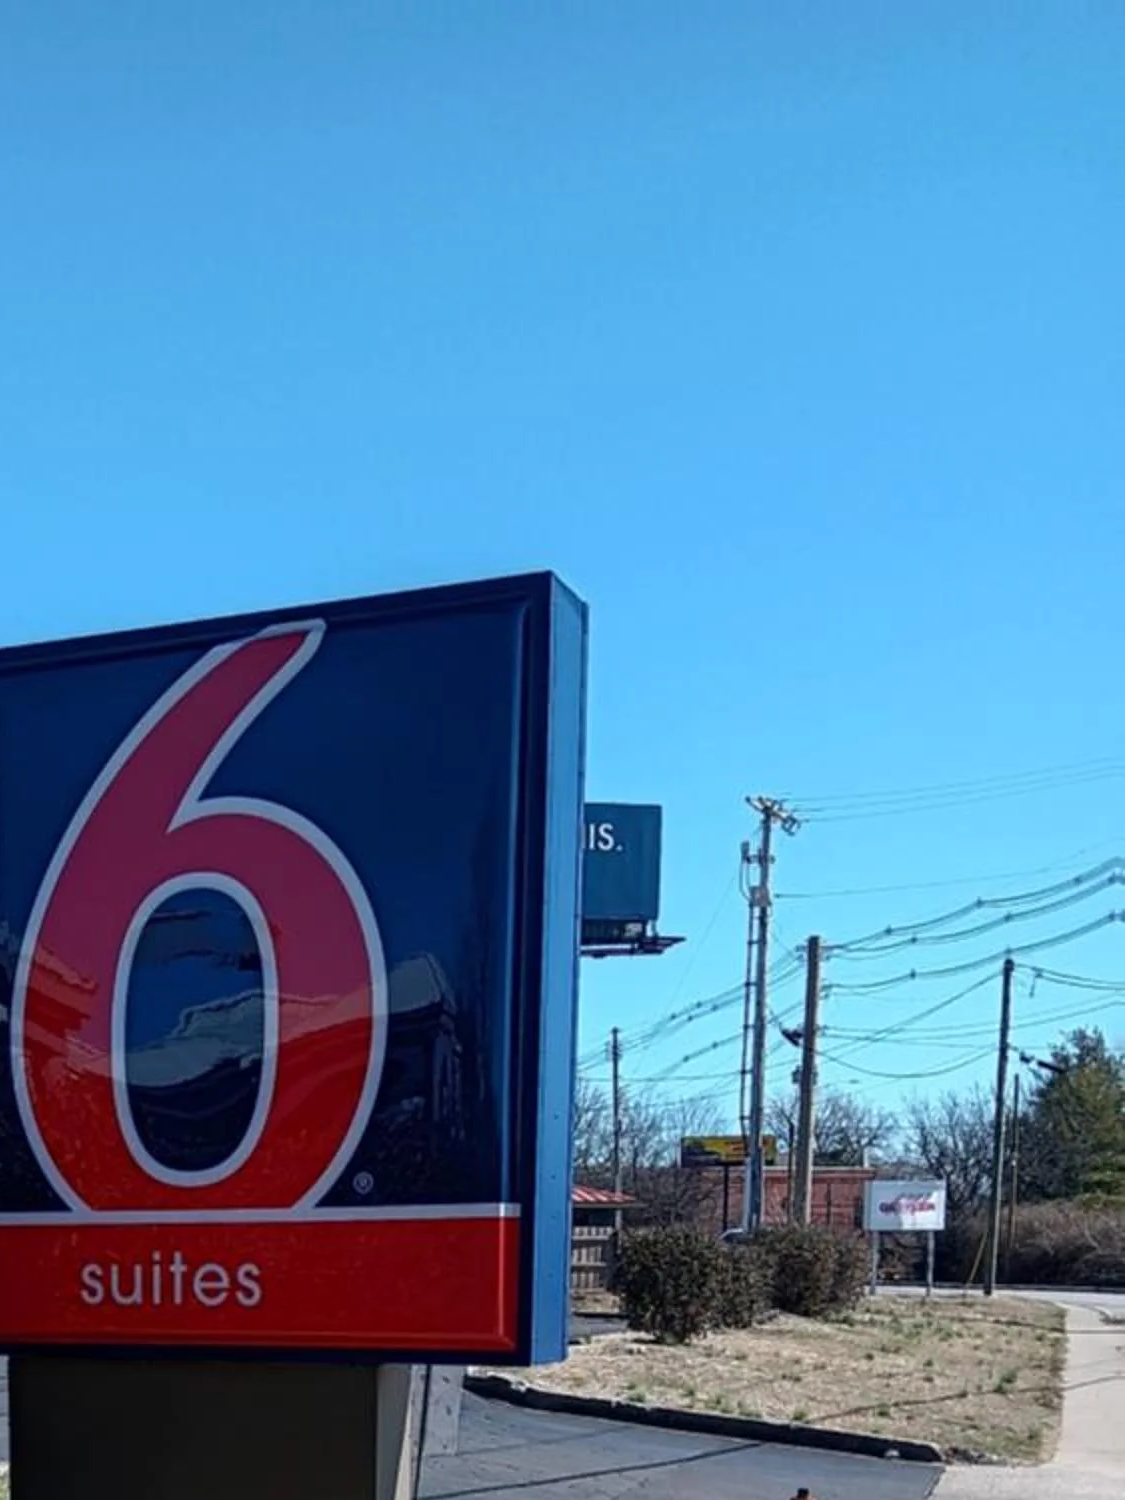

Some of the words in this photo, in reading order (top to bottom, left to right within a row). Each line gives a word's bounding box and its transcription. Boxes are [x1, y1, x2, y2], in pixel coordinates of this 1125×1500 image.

[581, 823, 623, 852] IS.
[12, 617, 388, 1213] 6
[80, 1250, 262, 1307] suites
